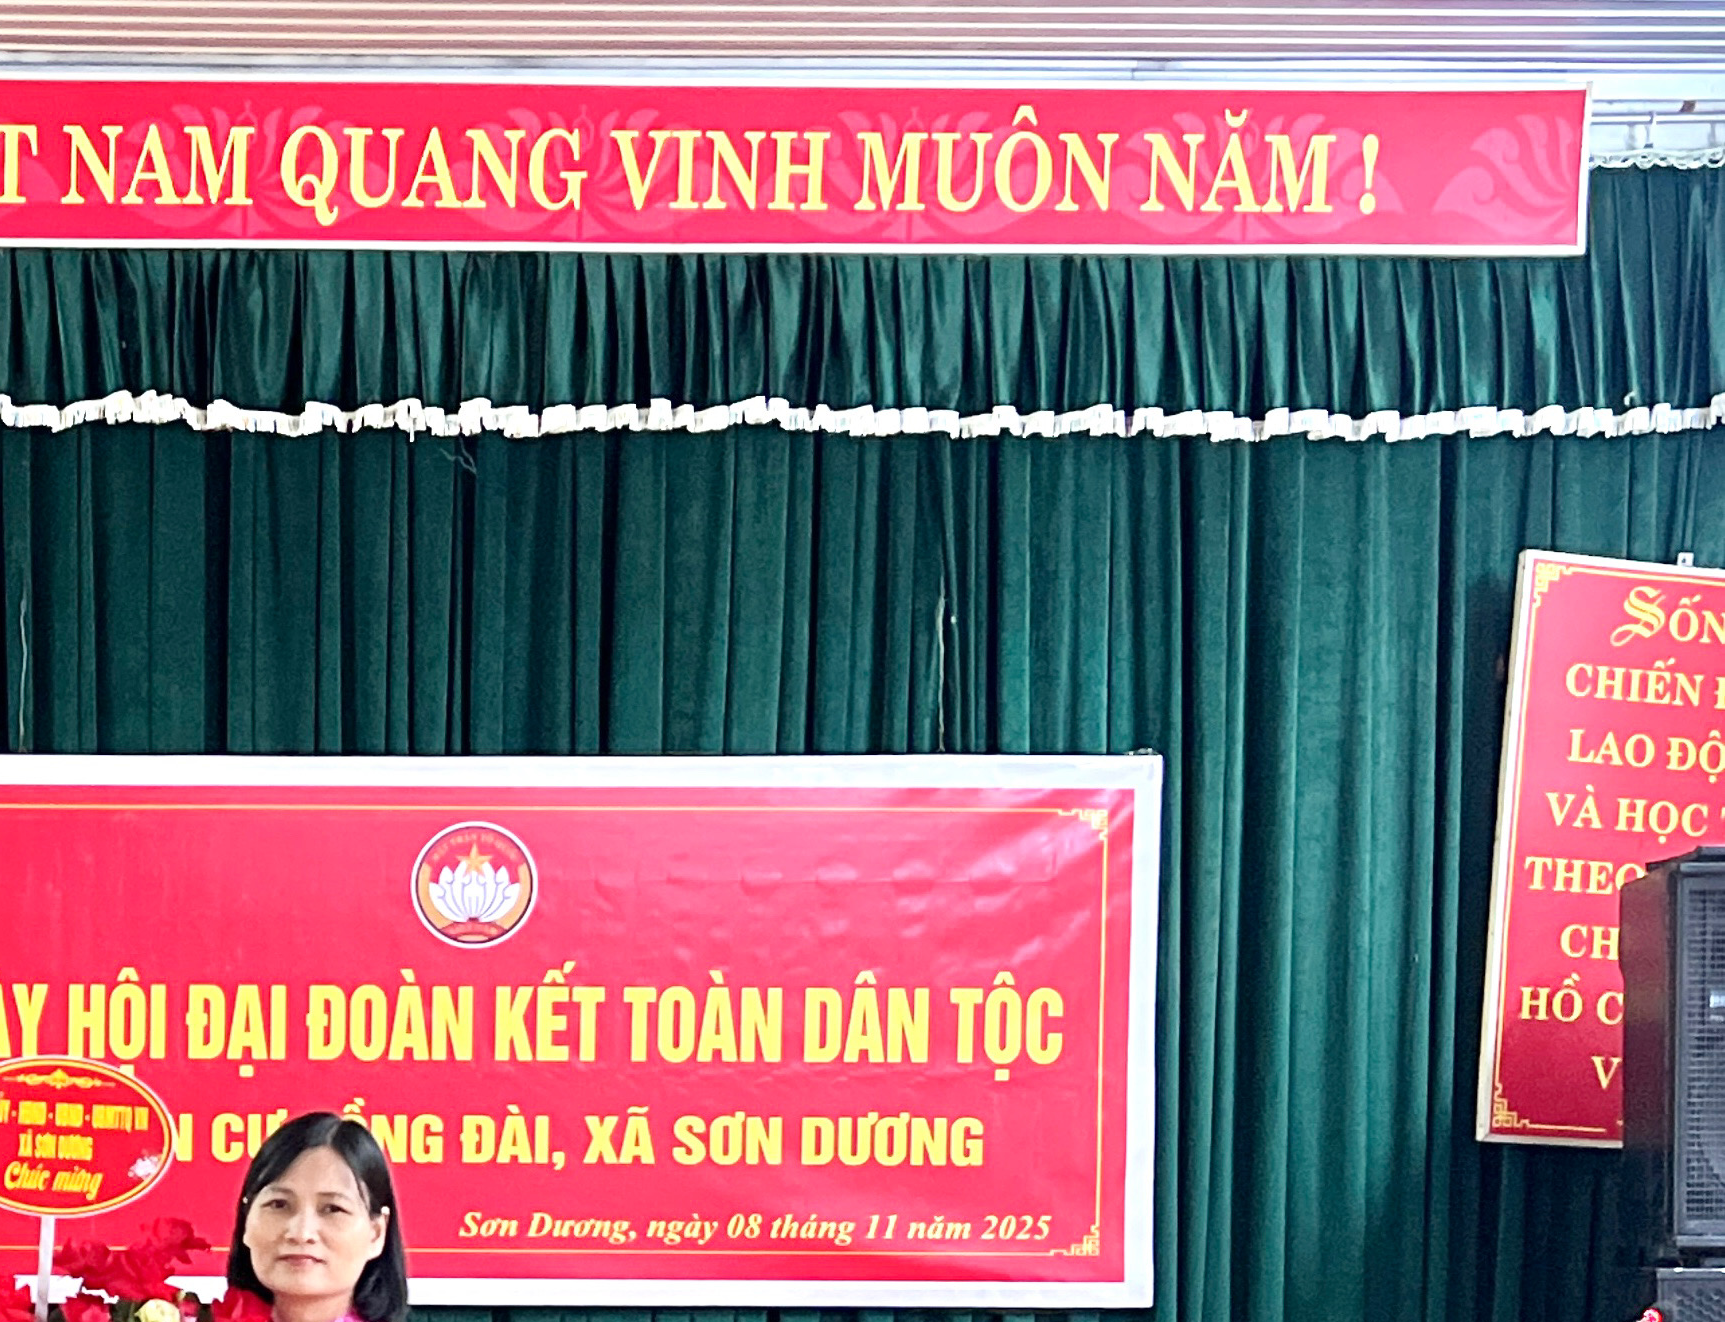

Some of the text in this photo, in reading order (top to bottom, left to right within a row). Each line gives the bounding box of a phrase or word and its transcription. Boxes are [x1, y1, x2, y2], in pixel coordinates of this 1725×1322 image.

[62, 124, 254, 204] NAM
[281, 126, 587, 226] QUANG
[610, 130, 830, 210] VINH
[854, 106, 1112, 212] MUÔN
[1140, 109, 1336, 212] NĂM
[1360, 134, 1378, 214] !
[1610, 586, 1725, 646] SỐN
[1566, 658, 1704, 706] CHIẾN
[1568, 729, 1725, 783] LAO ĐỘ
[1546, 784, 1708, 843] VÀ HỌC
[1561, 924, 1619, 960] CH
[69, 967, 166, 1077] HỘI
[186, 985, 286, 1077] ĐẠI
[306, 969, 473, 1060] ĐOÀN
[495, 961, 605, 1061] KẾT
[624, 970, 782, 1062] TOÀN
[804, 970, 929, 1062] DÂN
[950, 972, 1063, 1081] TỘC
[1520, 973, 1582, 1021] HỒ
[343, 1098, 443, 1163] NG
[460, 1105, 565, 1170] ĐÀI,
[584, 1107, 654, 1164] XÃ
[673, 1112, 782, 1164] SƠN
[802, 1112, 983, 1166] DƯƠNG
[459, 1212, 1051, 1245] Sơn Dương, ngày 08 tháng 11 năm 2025
